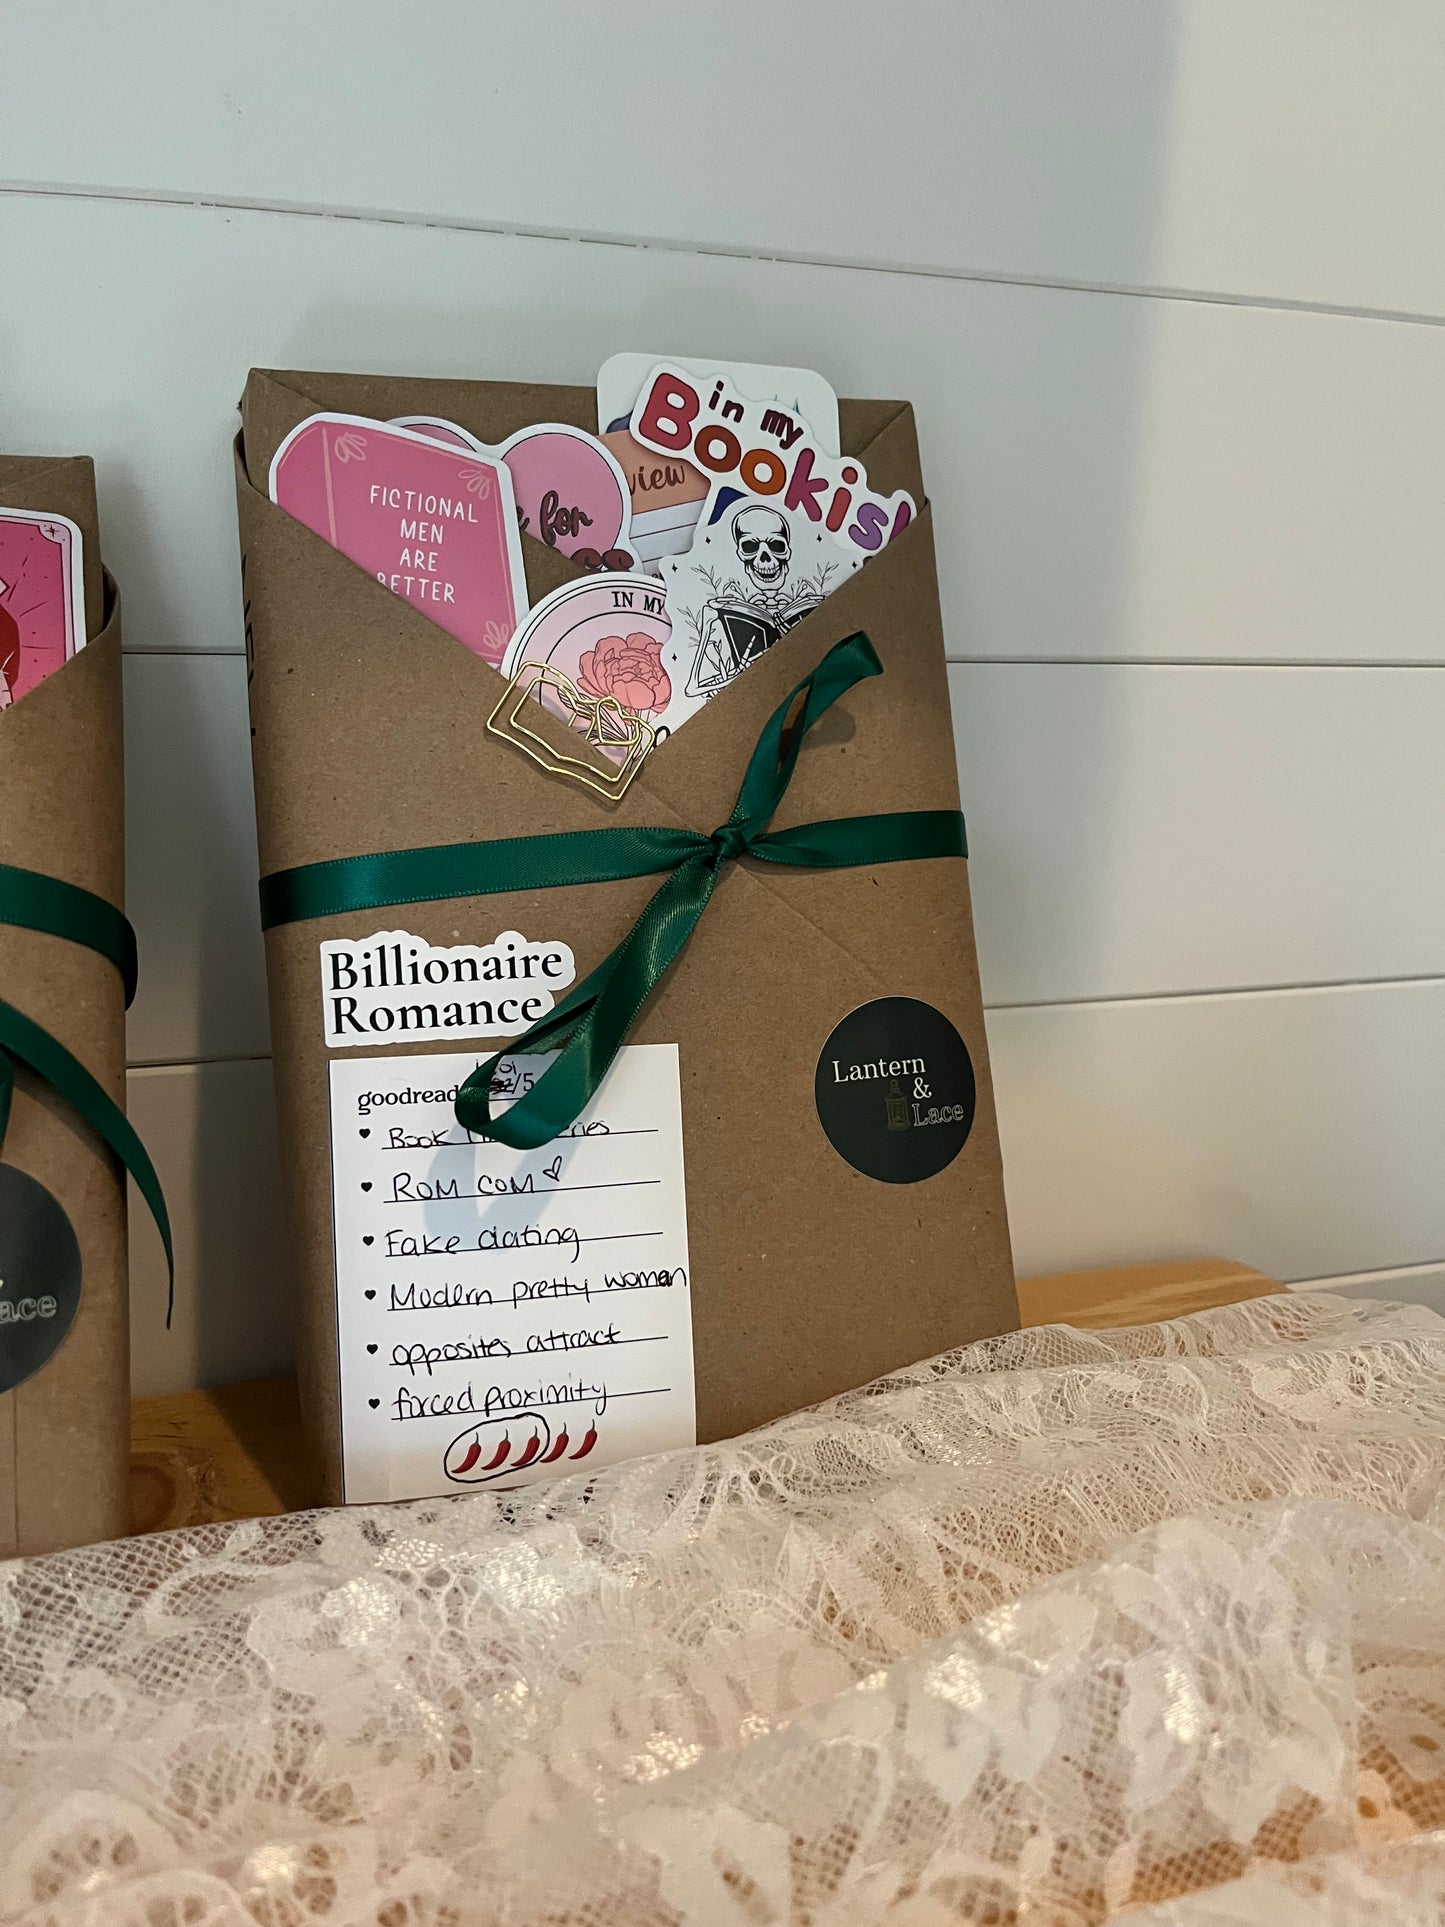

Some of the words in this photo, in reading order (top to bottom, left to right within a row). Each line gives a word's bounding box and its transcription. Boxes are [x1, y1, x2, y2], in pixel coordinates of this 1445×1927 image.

[708, 380, 745, 423] in
[759, 409, 804, 450] my
[630, 465, 685, 496] view
[370, 484, 478, 523] FICTIONAL
[539, 490, 593, 546] for
[400, 518, 443, 545] MEN
[399, 547, 439, 572] ARE
[611, 590, 635, 609] IN
[328, 943, 563, 990] Billionaire
[330, 996, 542, 1035] Romance
[832, 1057, 926, 1083] Lantern
[357, 1084, 459, 1116] goodread
[912, 1077, 932, 1100] &
[911, 1102, 964, 1127] Lace
[388, 1127, 452, 1149] Book
[571, 1120, 610, 1137] ries
[385, 1228, 461, 1256] Fake
[477, 1224, 581, 1263] dating
[390, 1283, 493, 1309] Modern
[512, 1275, 591, 1309] pretty
[0, 1295, 57, 1324] ace
[526, 1322, 621, 1352] attract
